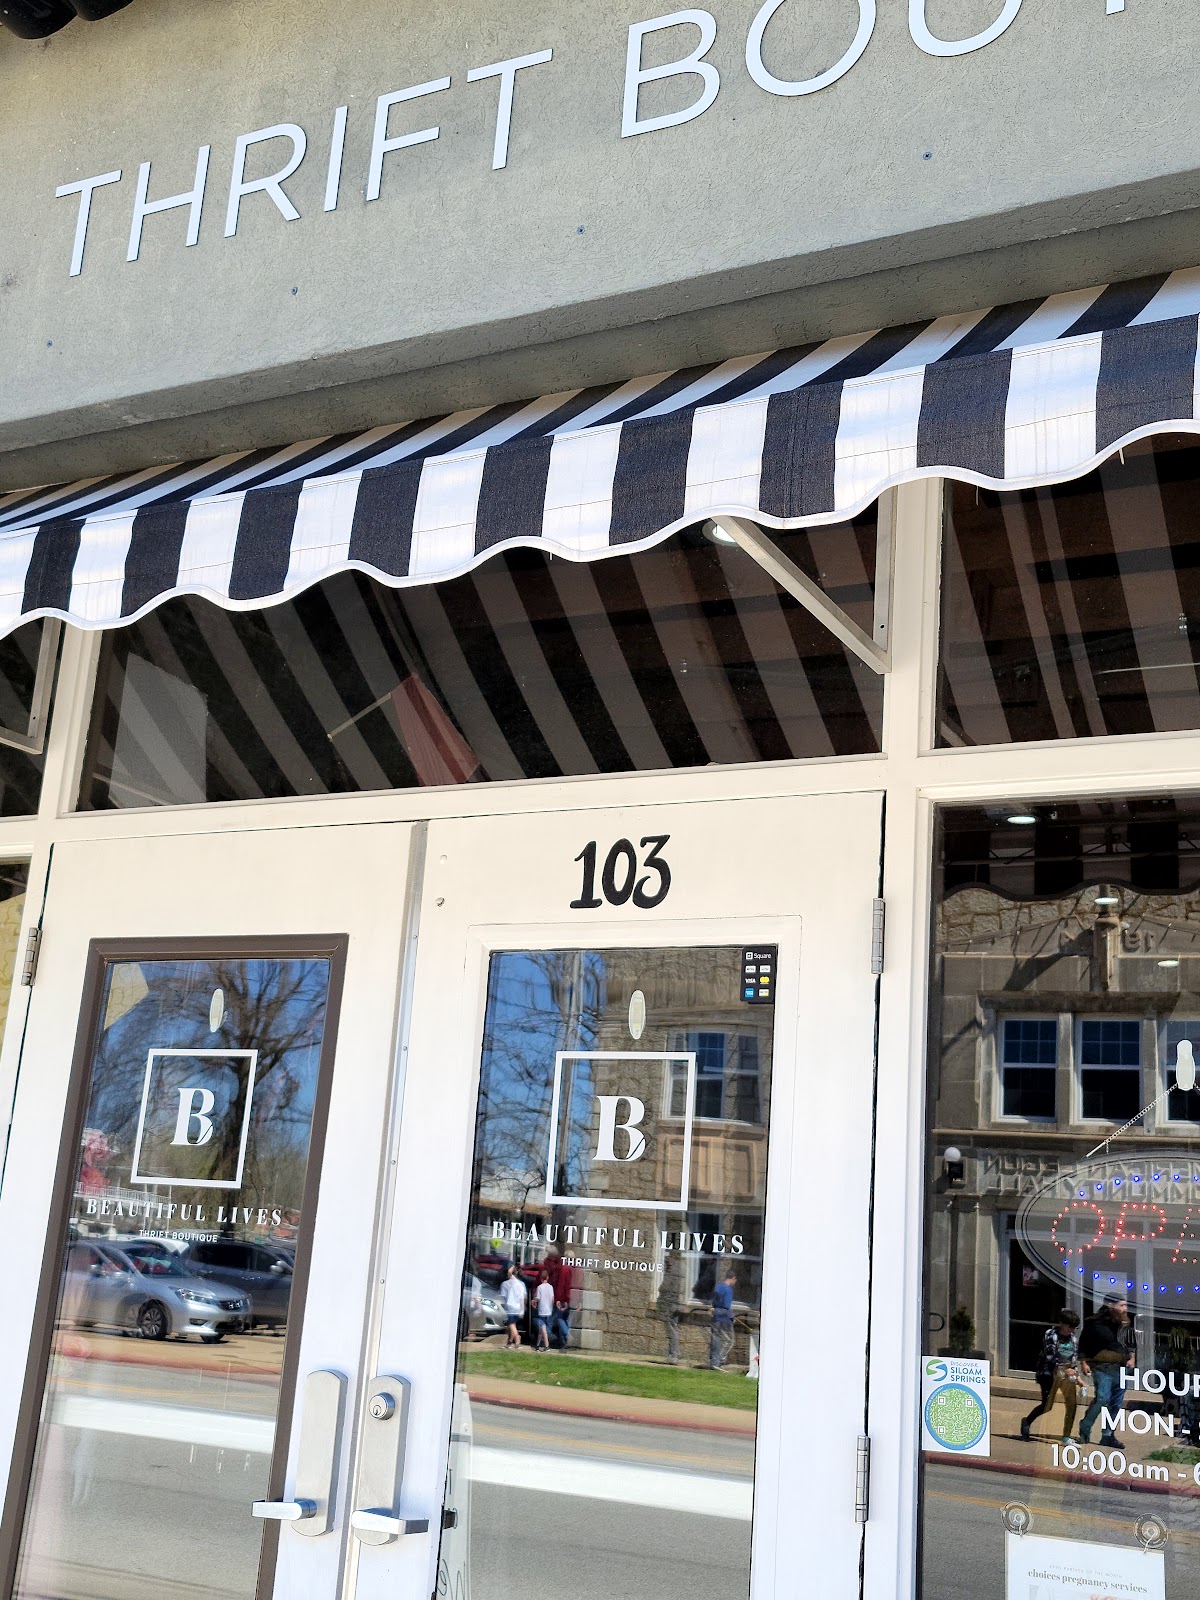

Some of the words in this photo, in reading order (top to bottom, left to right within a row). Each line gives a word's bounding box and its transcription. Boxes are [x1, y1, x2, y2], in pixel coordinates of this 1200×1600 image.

[55, 48, 553, 278] THRIFT
[569, 834, 672, 909] 103
[753, 952, 772, 960] Square
[170, 1087, 215, 1146] B
[592, 1095, 647, 1162] B
[86, 1198, 206, 1221] BEAUTIFUL
[217, 1206, 282, 1227] LIVES
[139, 1229, 170, 1240] THRIFT
[172, 1230, 218, 1243] BOUTIQUE
[492, 1220, 645, 1248] BEAUTIFUL
[660, 1230, 745, 1255] LIVES
[561, 1256, 600, 1268] THRIFT
[604, 1259, 663, 1273] BOUTIQUE
[950, 1366, 982, 1376] SILOAM
[950, 1374, 986, 1384] SPRINGS
[1051, 1443, 1169, 1482] 10:00am
[1028, 1568, 1061, 1581] choices
[1062, 1575, 1109, 1590] pregnancy
[1110, 1581, 1148, 1594] services
